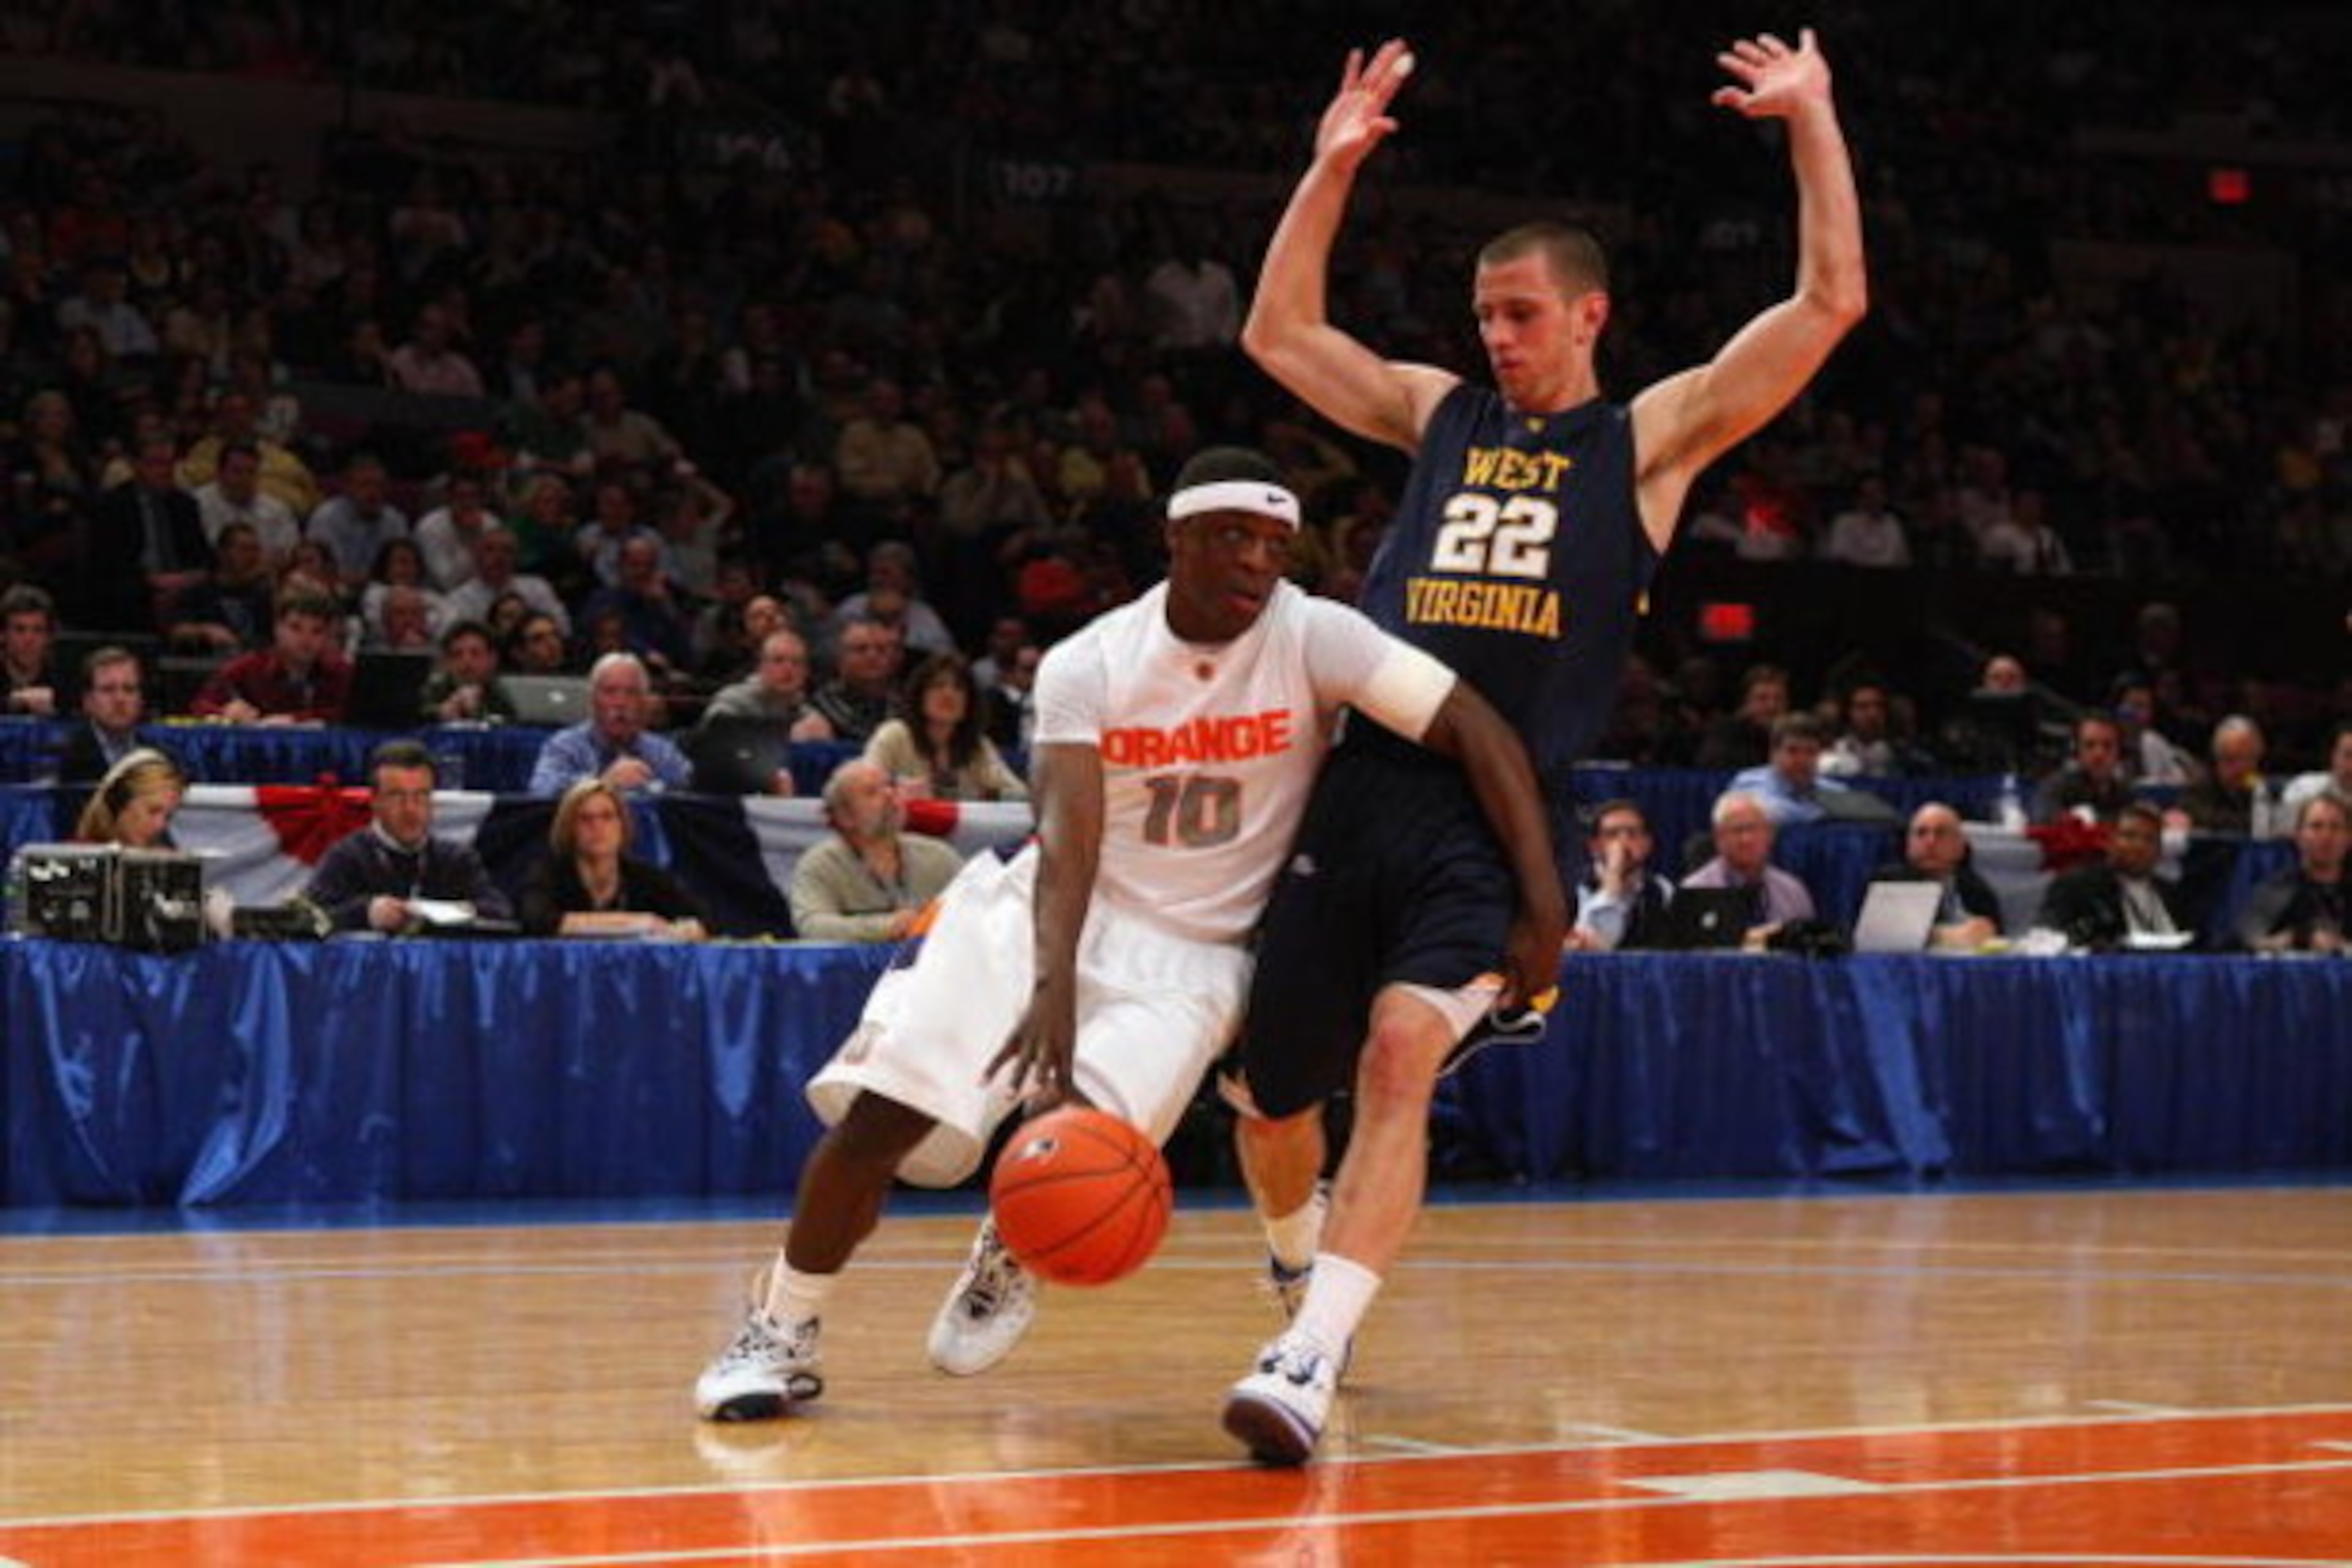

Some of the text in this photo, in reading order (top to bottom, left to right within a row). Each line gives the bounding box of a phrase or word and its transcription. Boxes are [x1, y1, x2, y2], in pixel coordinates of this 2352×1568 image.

[1464, 447, 1571, 491] WEST
[1430, 492, 1559, 579] 22
[1407, 578, 1562, 639] VIRGINIA
[1101, 709, 1291, 767] ORANGE
[1144, 777, 1241, 847] 10
